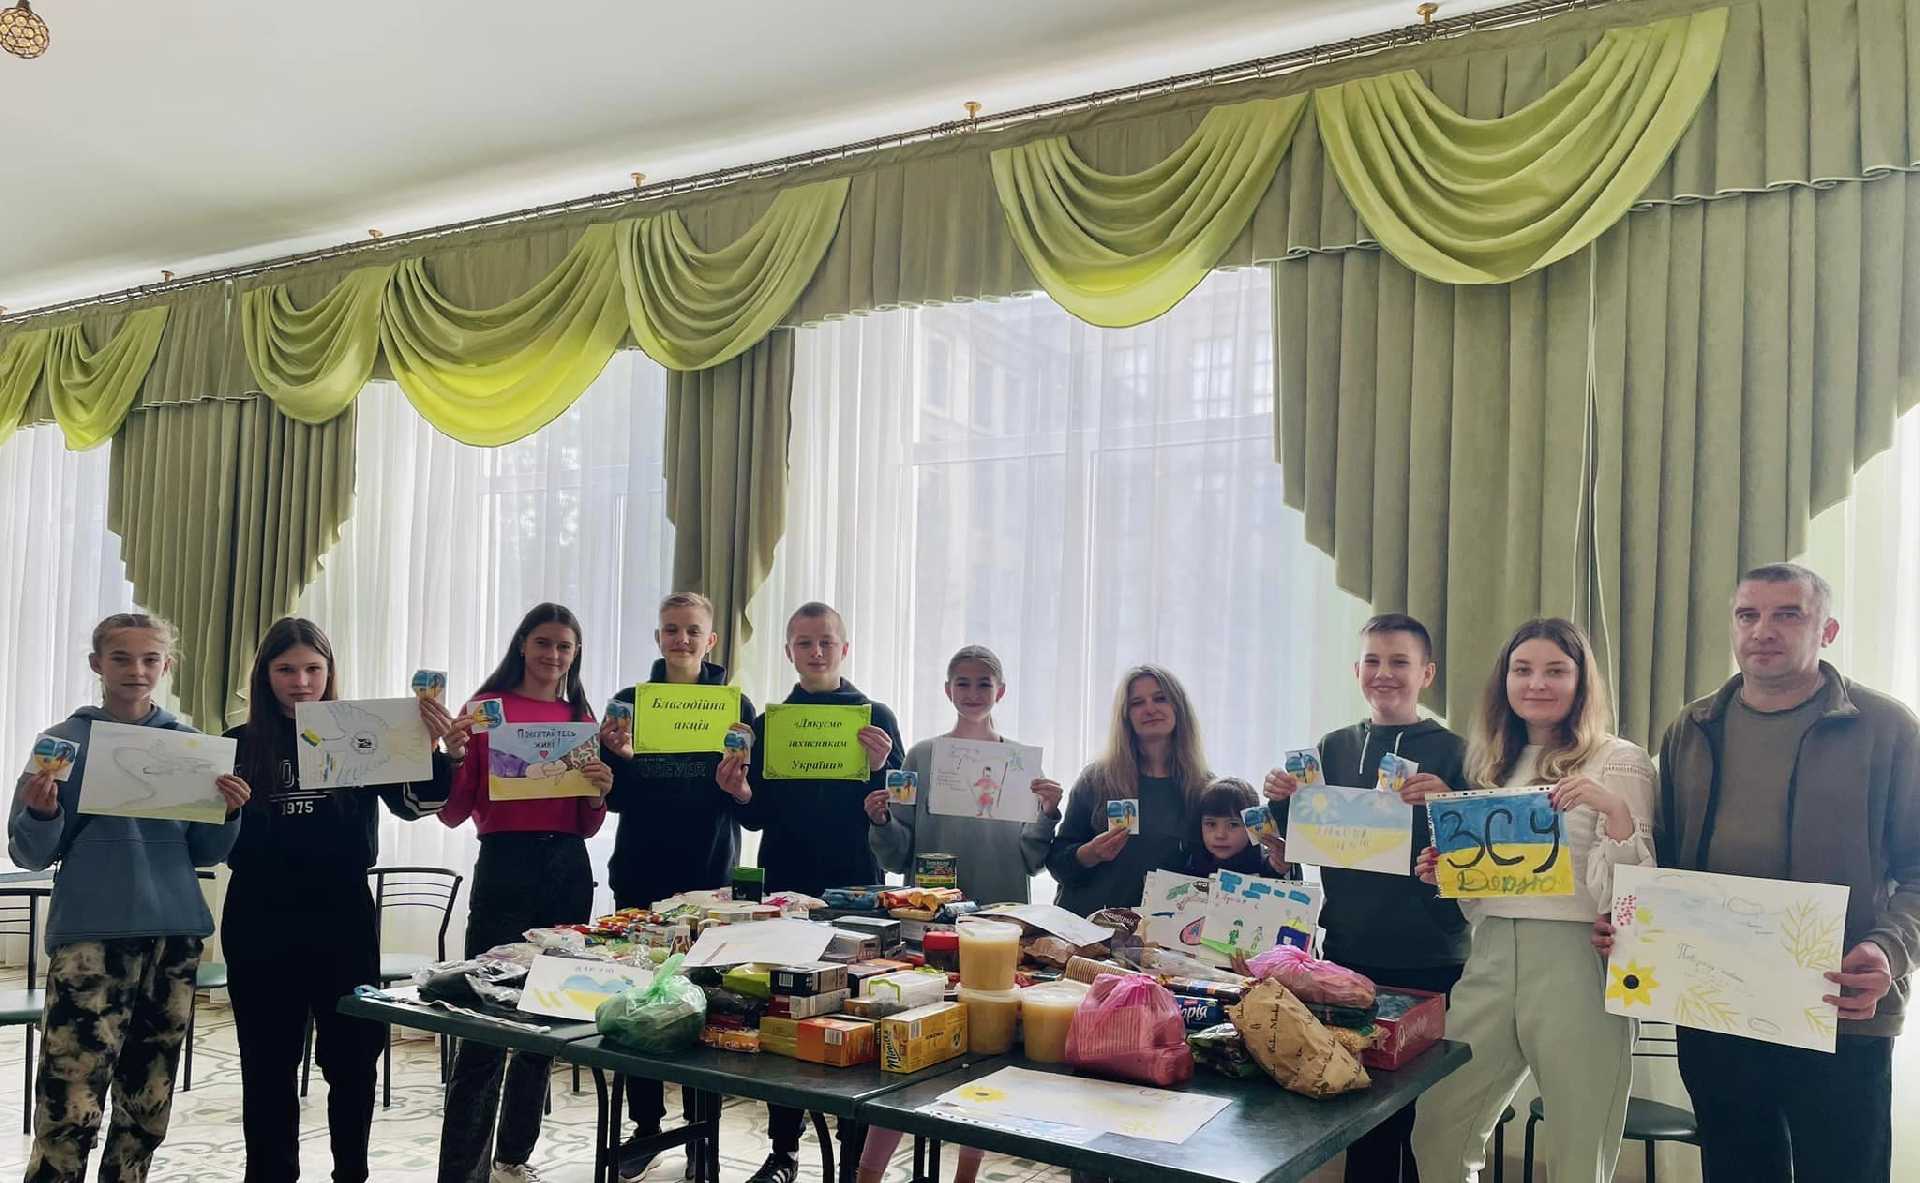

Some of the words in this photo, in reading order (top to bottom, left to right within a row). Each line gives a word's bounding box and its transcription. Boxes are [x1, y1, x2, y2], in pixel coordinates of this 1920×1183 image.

[652, 697, 726, 711] Благодійна
[673, 719, 710, 733] акція
[281, 801, 314, 816] 1975
[1440, 808, 1560, 873] ЗСУ
